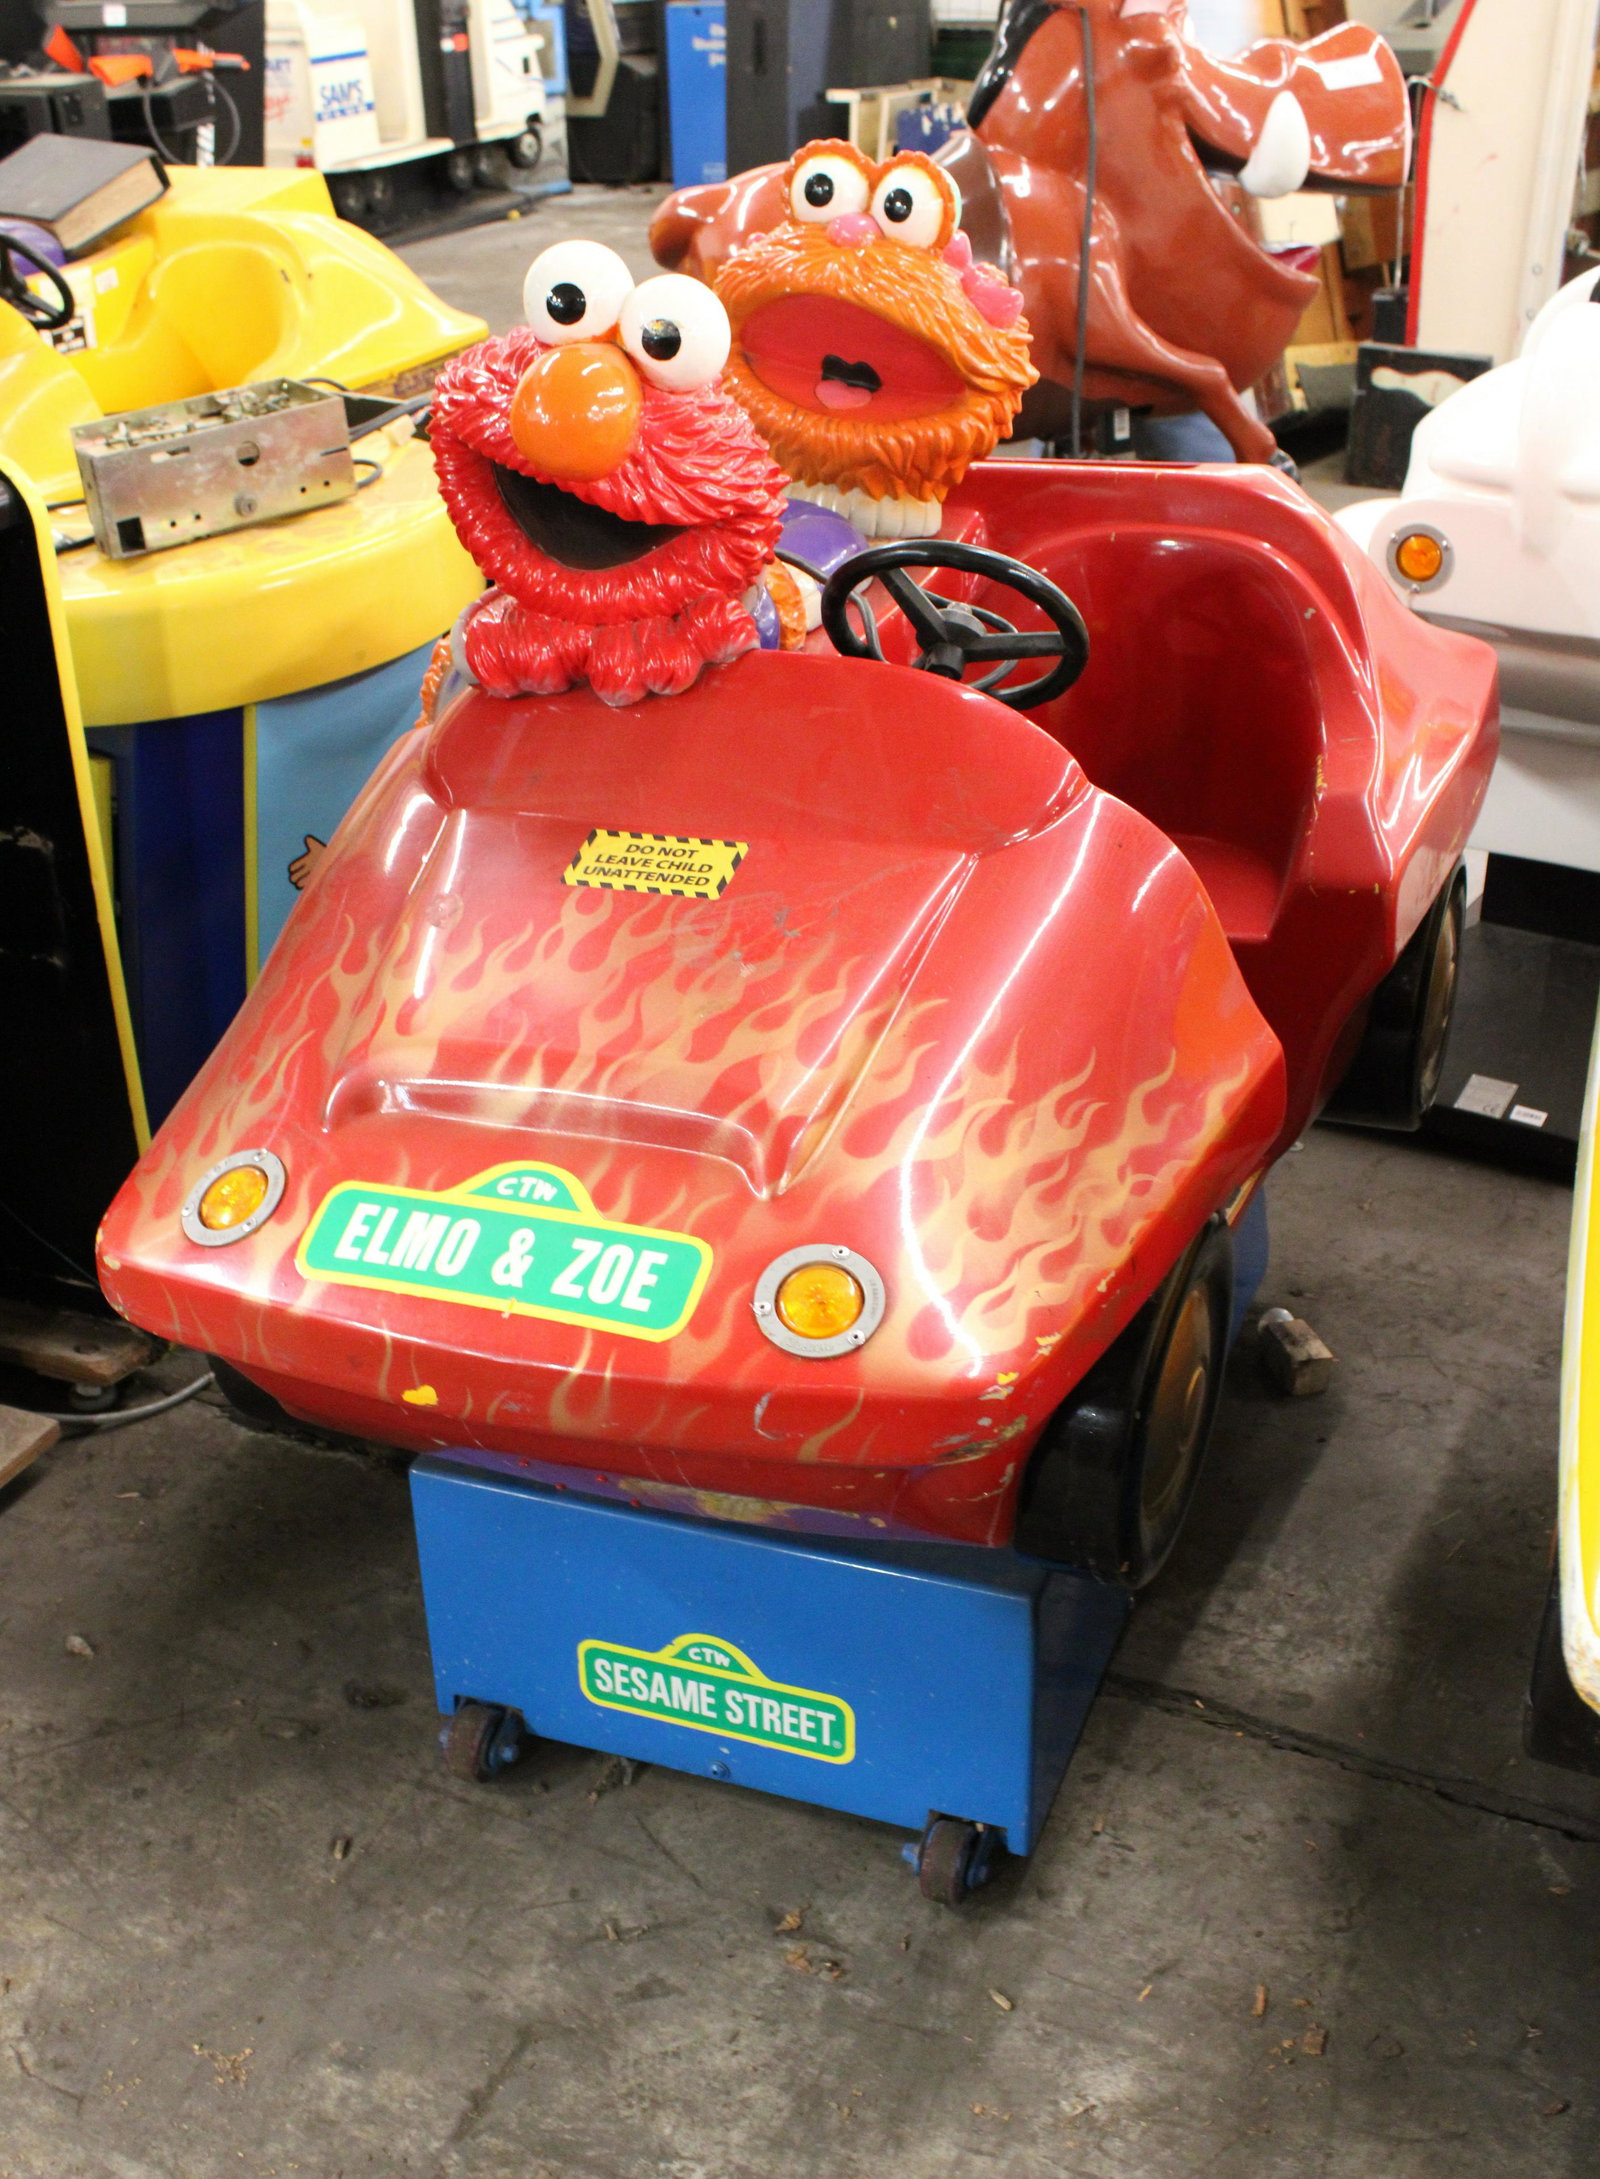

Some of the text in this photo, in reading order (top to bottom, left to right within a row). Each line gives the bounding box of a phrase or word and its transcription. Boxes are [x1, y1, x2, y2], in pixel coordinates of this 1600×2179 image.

[625, 844, 699, 859] DO NOT
[594, 854, 713, 873] LEAVE CHILD
[583, 866, 710, 886] UNATTENDED
[496, 1176, 558, 1202] CTW
[333, 1202, 669, 1313] ELMO & ZOE
[688, 1646, 731, 1668] CTW
[594, 1658, 718, 1719] SESAME
